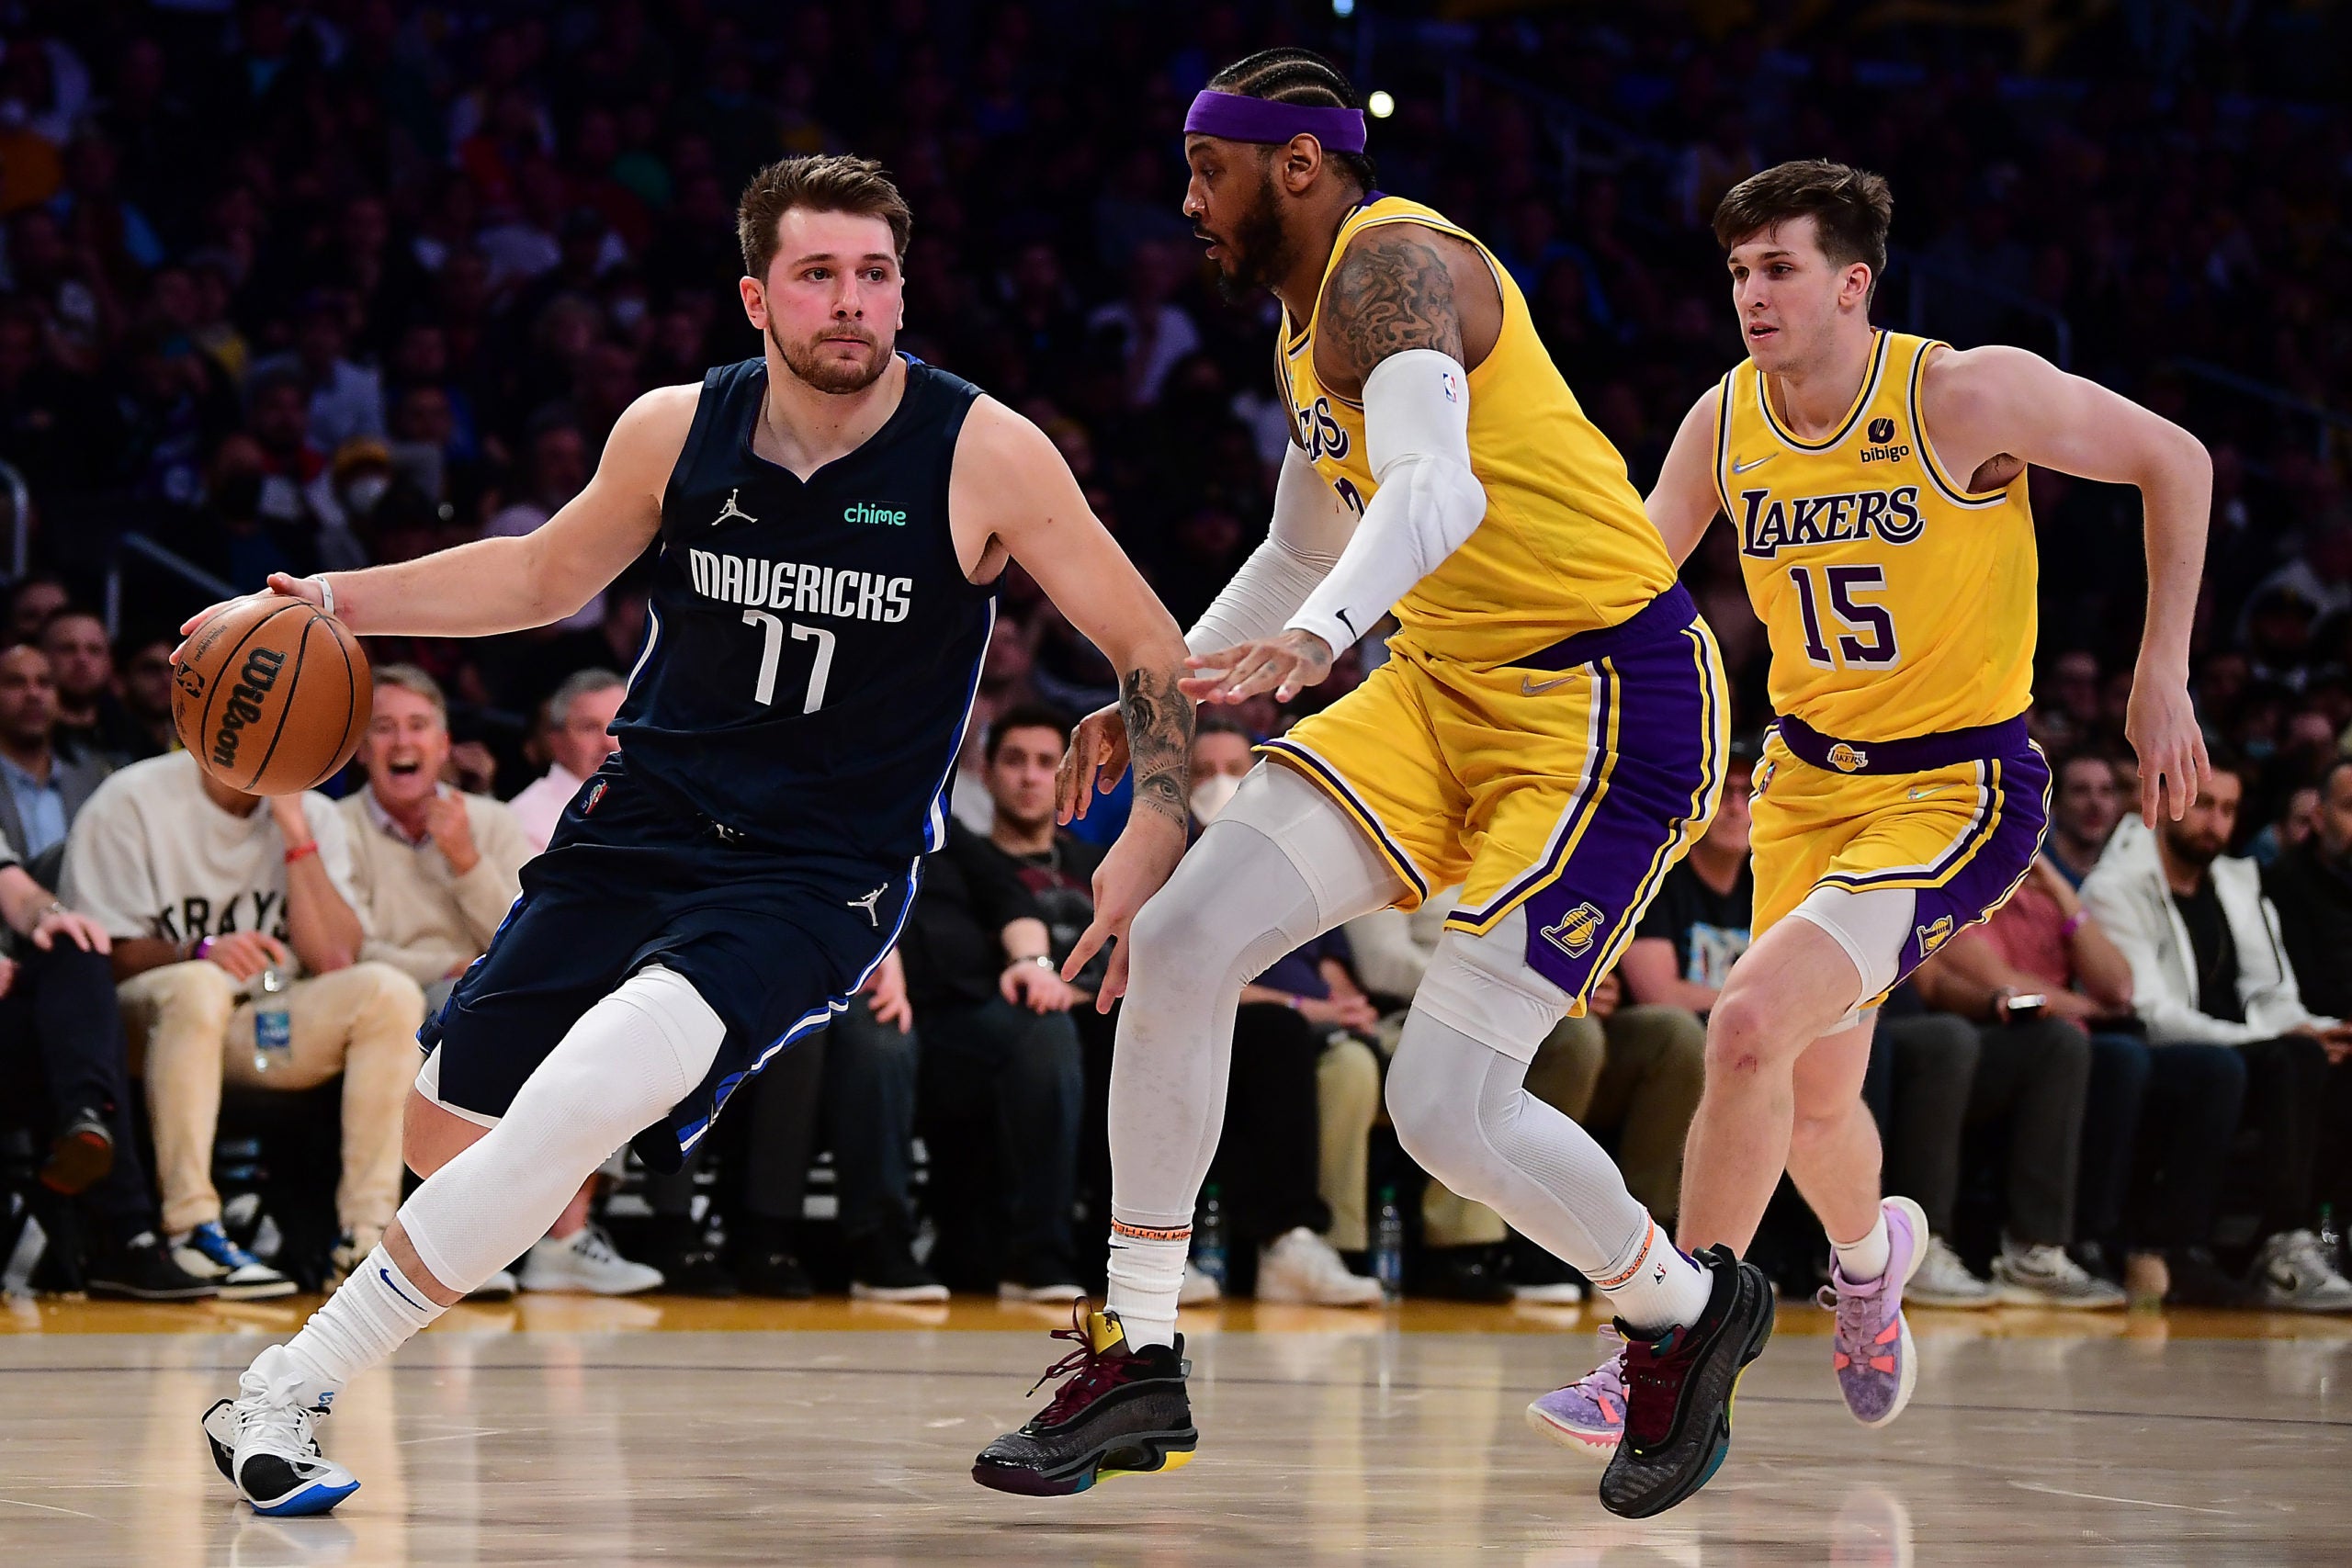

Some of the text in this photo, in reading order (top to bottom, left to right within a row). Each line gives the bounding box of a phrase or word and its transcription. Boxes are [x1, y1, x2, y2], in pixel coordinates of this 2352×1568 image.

[1860, 445, 1909, 463] bibigo
[843, 502, 907, 526] chime
[1741, 485, 1926, 559] LAKERS
[689, 547, 912, 623] MAVERICKS
[1787, 563, 1902, 671] 15
[741, 609, 835, 714] 77
[212, 647, 288, 770] Wilson
